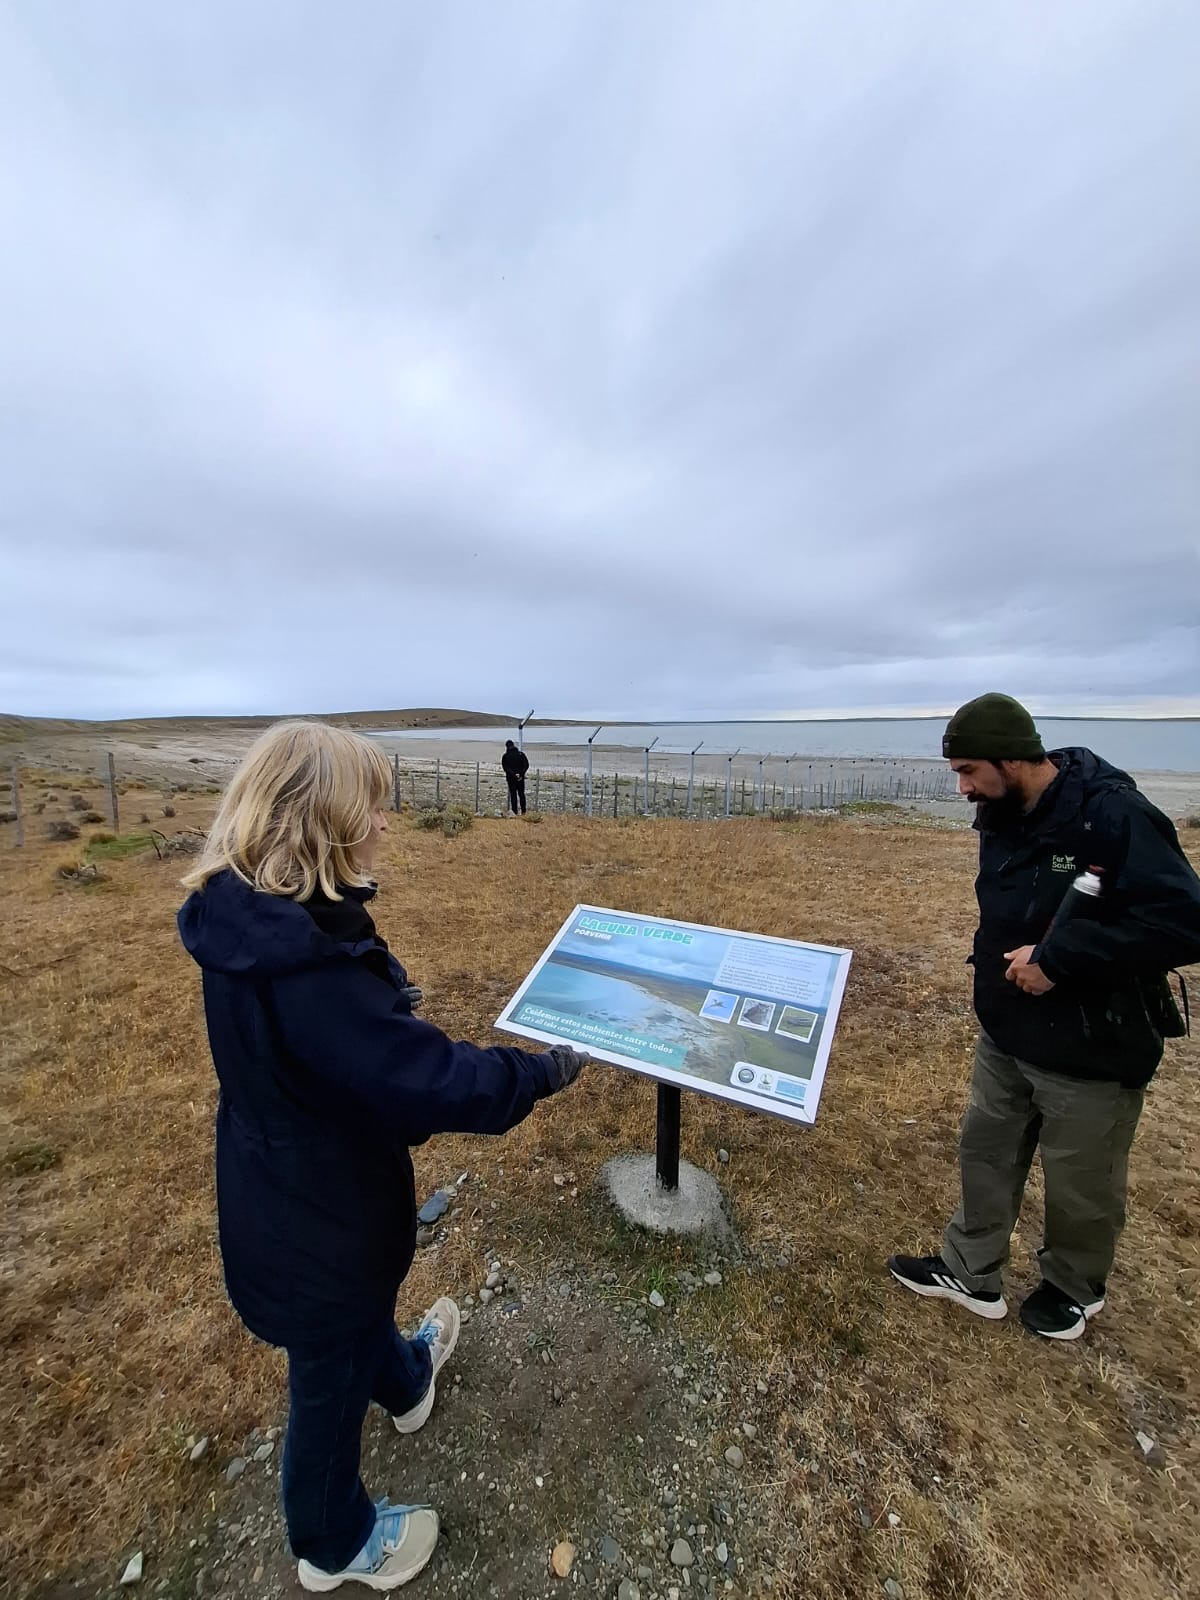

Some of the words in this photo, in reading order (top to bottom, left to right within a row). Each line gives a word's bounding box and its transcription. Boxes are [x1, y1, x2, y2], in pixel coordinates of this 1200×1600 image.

[1051, 861, 1076, 870] South
[574, 928, 612, 941] PORVENIR
[579, 916, 639, 936] LAGUNA
[642, 926, 694, 945] VERDE
[524, 1006, 560, 1023] Cuidemos
[561, 1016, 581, 1028] estos
[582, 1022, 623, 1041] ambientes
[624, 1035, 647, 1047] entre
[649, 1041, 674, 1055] todos
[535, 1017, 545, 1027] all
[545, 1019, 558, 1030] take
[570, 1028, 579, 1037] of
[578, 1029, 595, 1041] these
